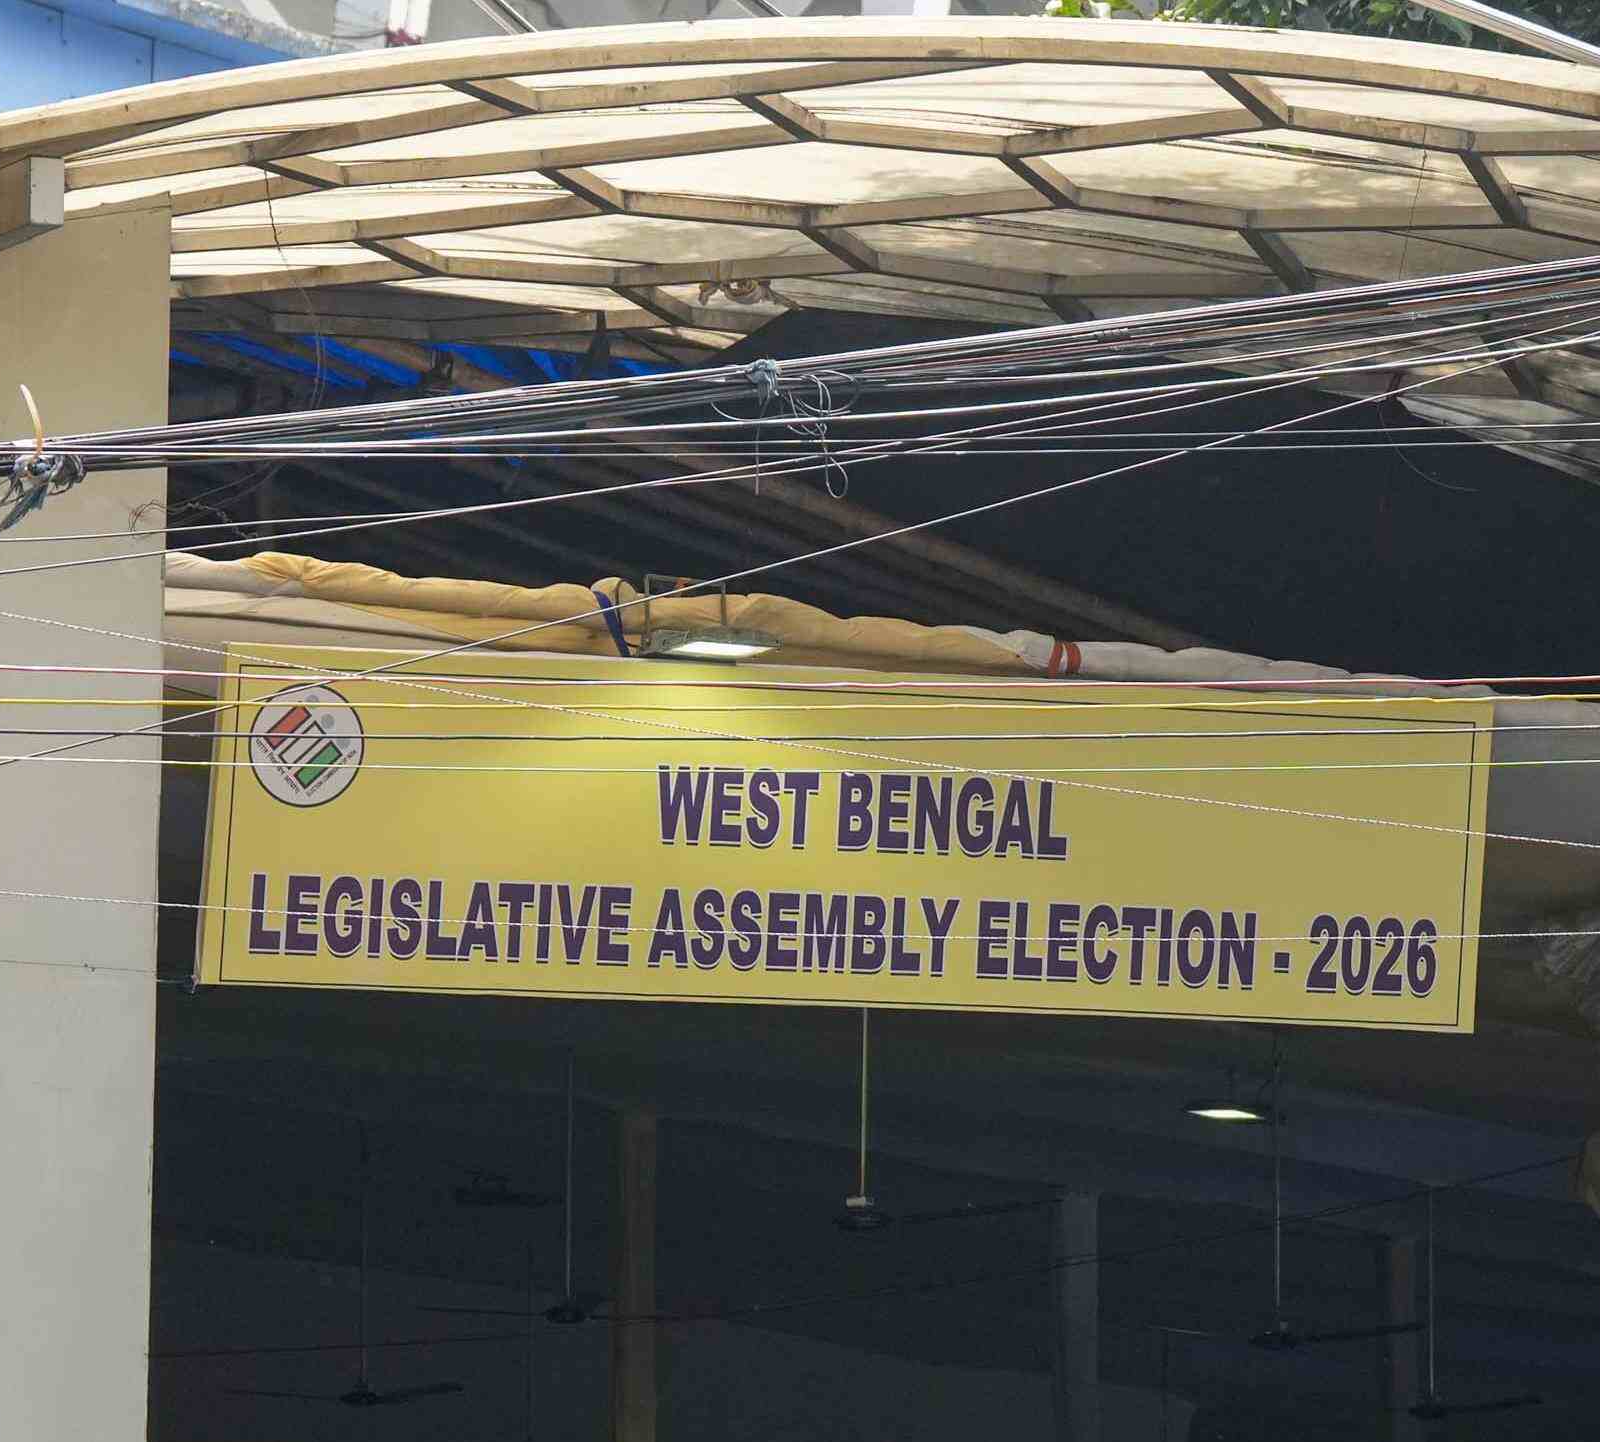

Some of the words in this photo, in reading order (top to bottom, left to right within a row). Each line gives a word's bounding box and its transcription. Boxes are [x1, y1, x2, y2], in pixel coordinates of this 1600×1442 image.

[659, 767, 820, 846] WEST
[837, 770, 1068, 859] BENGAL
[249, 871, 632, 966] LEGISLATIVE
[649, 886, 961, 976] ASSEMBLY
[977, 897, 1258, 987] ELECTION
[1272, 952, 1291, 971] -
[1305, 913, 1437, 996] 2026
